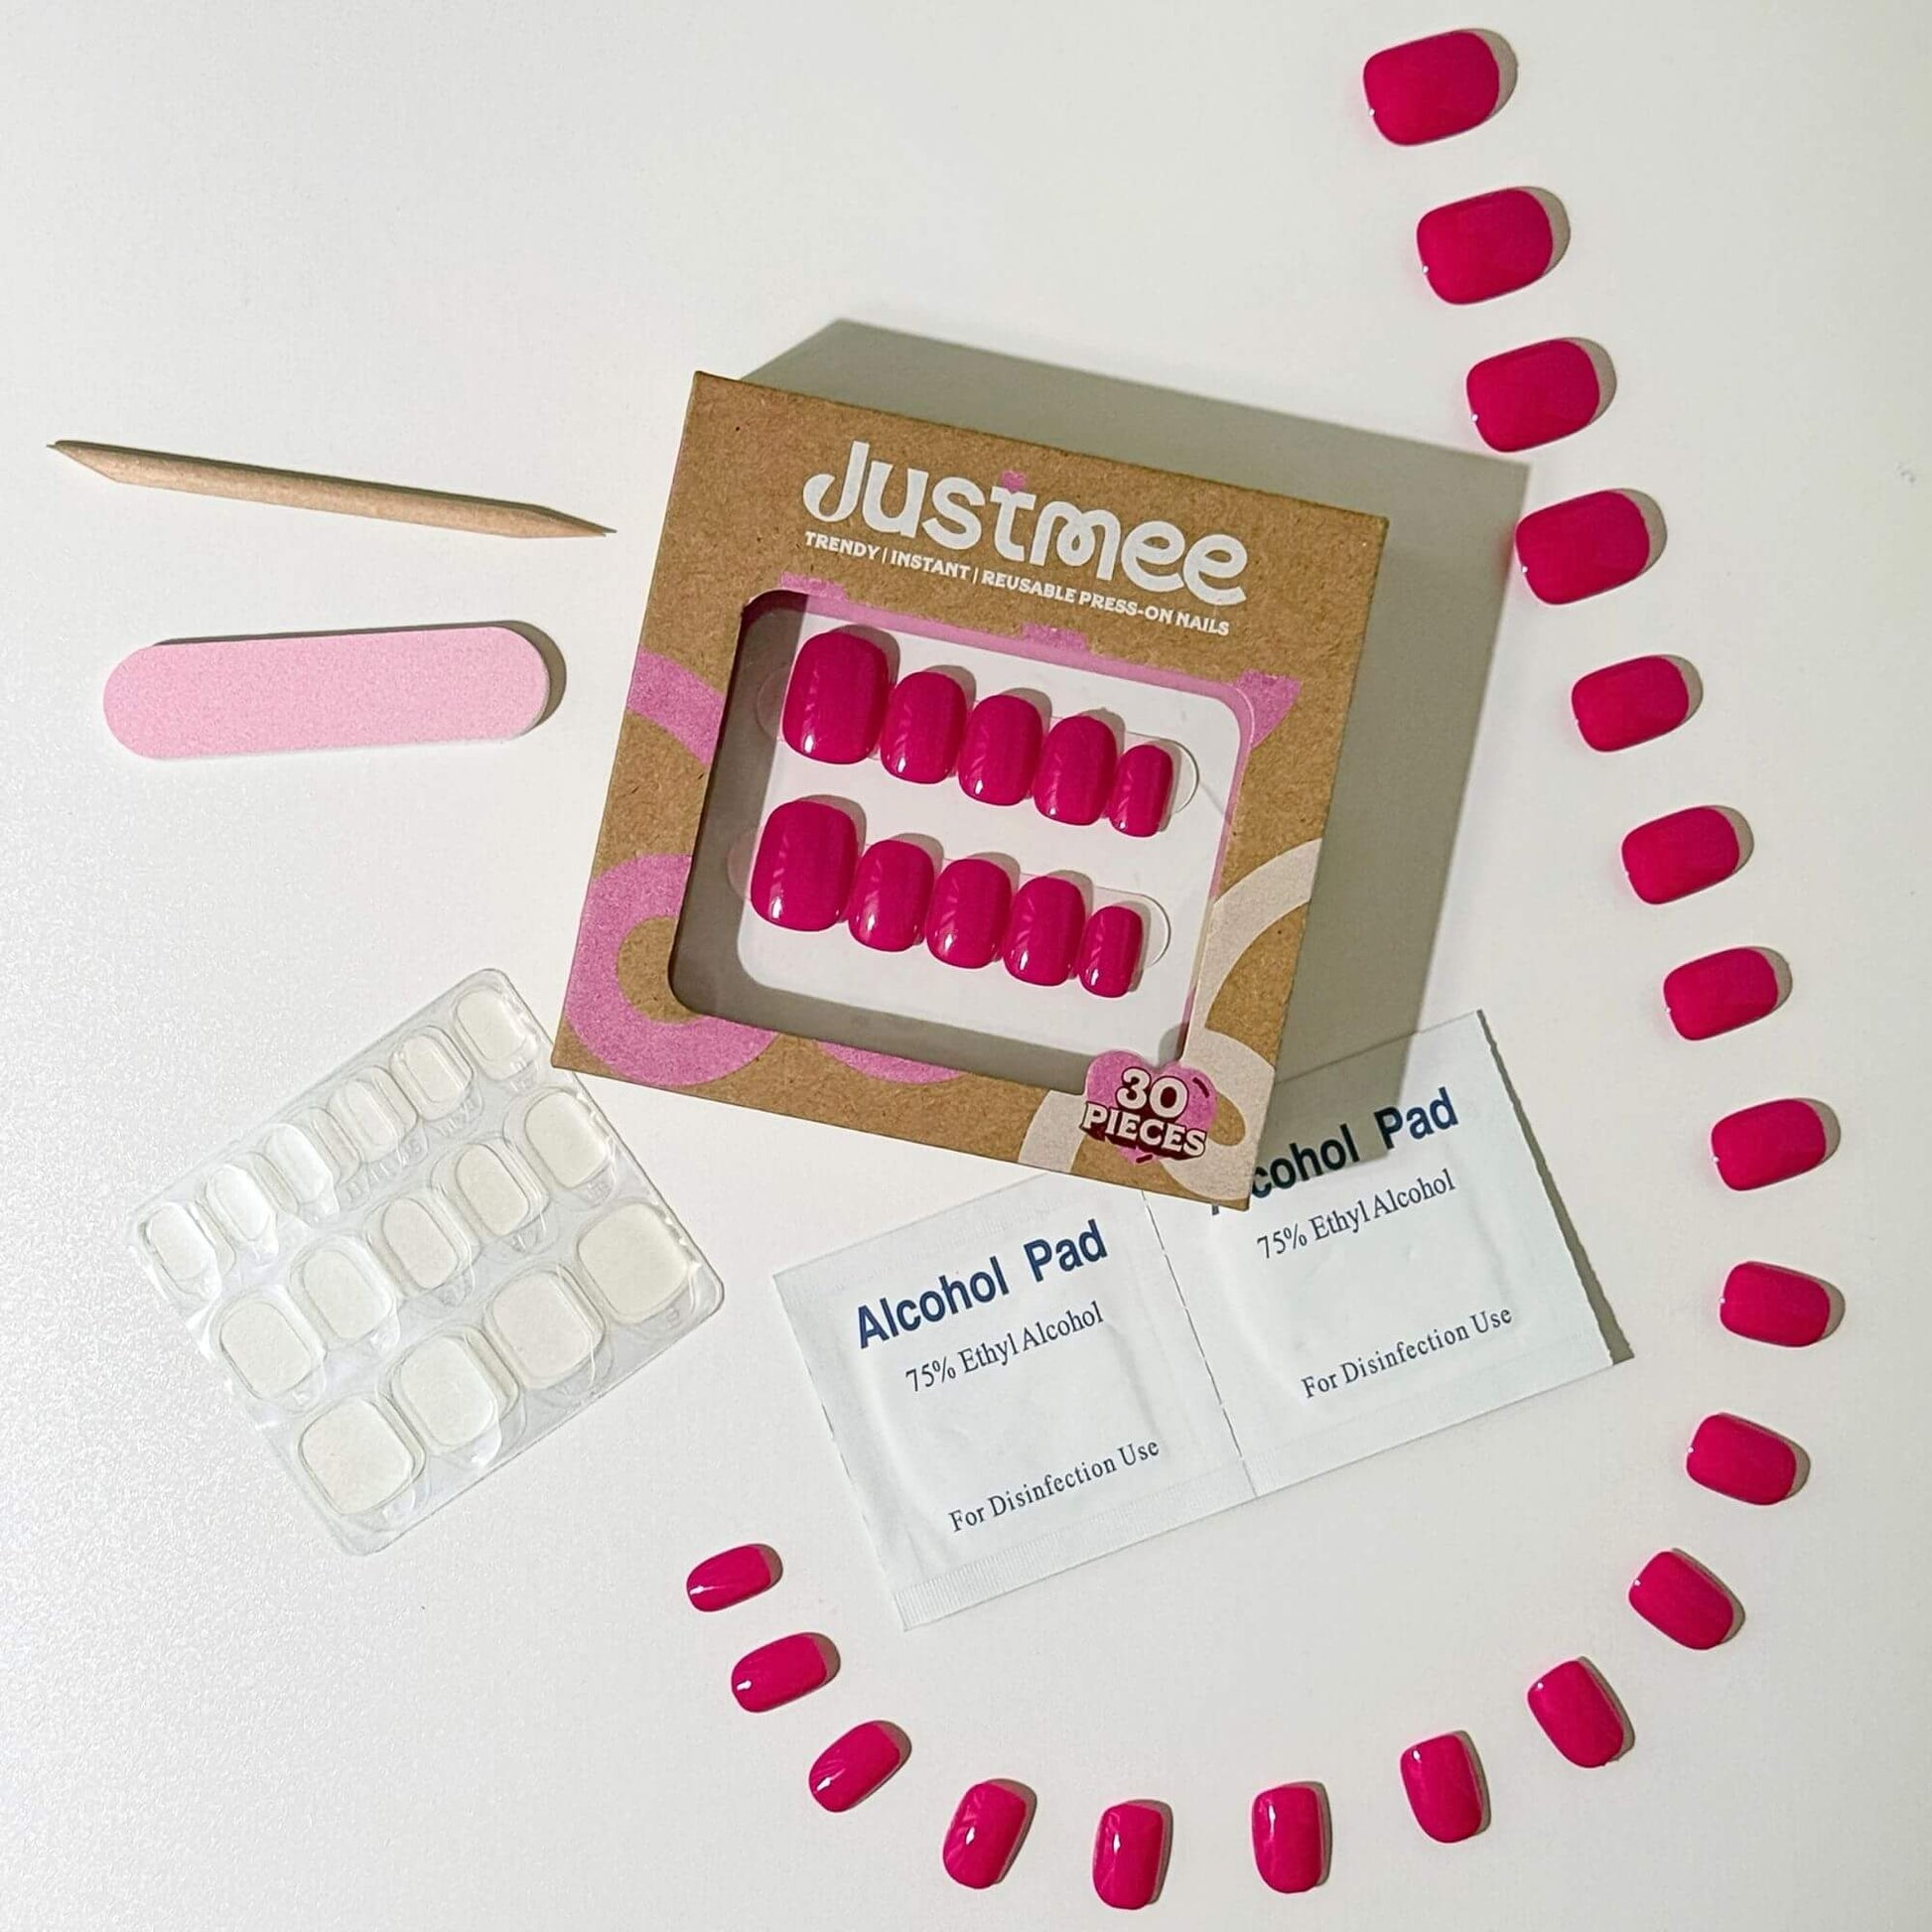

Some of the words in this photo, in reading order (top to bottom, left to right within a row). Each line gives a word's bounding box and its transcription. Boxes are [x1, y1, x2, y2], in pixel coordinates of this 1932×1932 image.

[802, 440, 1248, 606] Justmee
[804, 530, 882, 563] TRENDY
[891, 550, 970, 581] INSTANT
[981, 570, 1076, 604] REUSABLE
[1077, 591, 1173, 624] PRESS-ON
[1175, 611, 1230, 636] NAILS
[1080, 1101, 1208, 1161] PIECES
[1115, 1066, 1189, 1119] 30
[1210, 1123, 1361, 1215] cohol
[1373, 1086, 1459, 1150] Pad
[1257, 1223, 1309, 1259] 75%
[1309, 1199, 1370, 1243] Ethyl
[1373, 1168, 1456, 1218] Alcohol
[858, 1256, 1010, 1349] Alcohol
[1023, 1218, 1109, 1283] Pad
[905, 1355, 956, 1393] 75%
[957, 1332, 1019, 1375] Ethyl
[1021, 1301, 1105, 1352] Alcohol
[1301, 1373, 1339, 1400] For
[1340, 1324, 1472, 1385] Disinfection
[1473, 1306, 1514, 1332] Use
[948, 1506, 987, 1533] For
[987, 1456, 1119, 1519] Disinfection
[1119, 1439, 1162, 1467] Use
